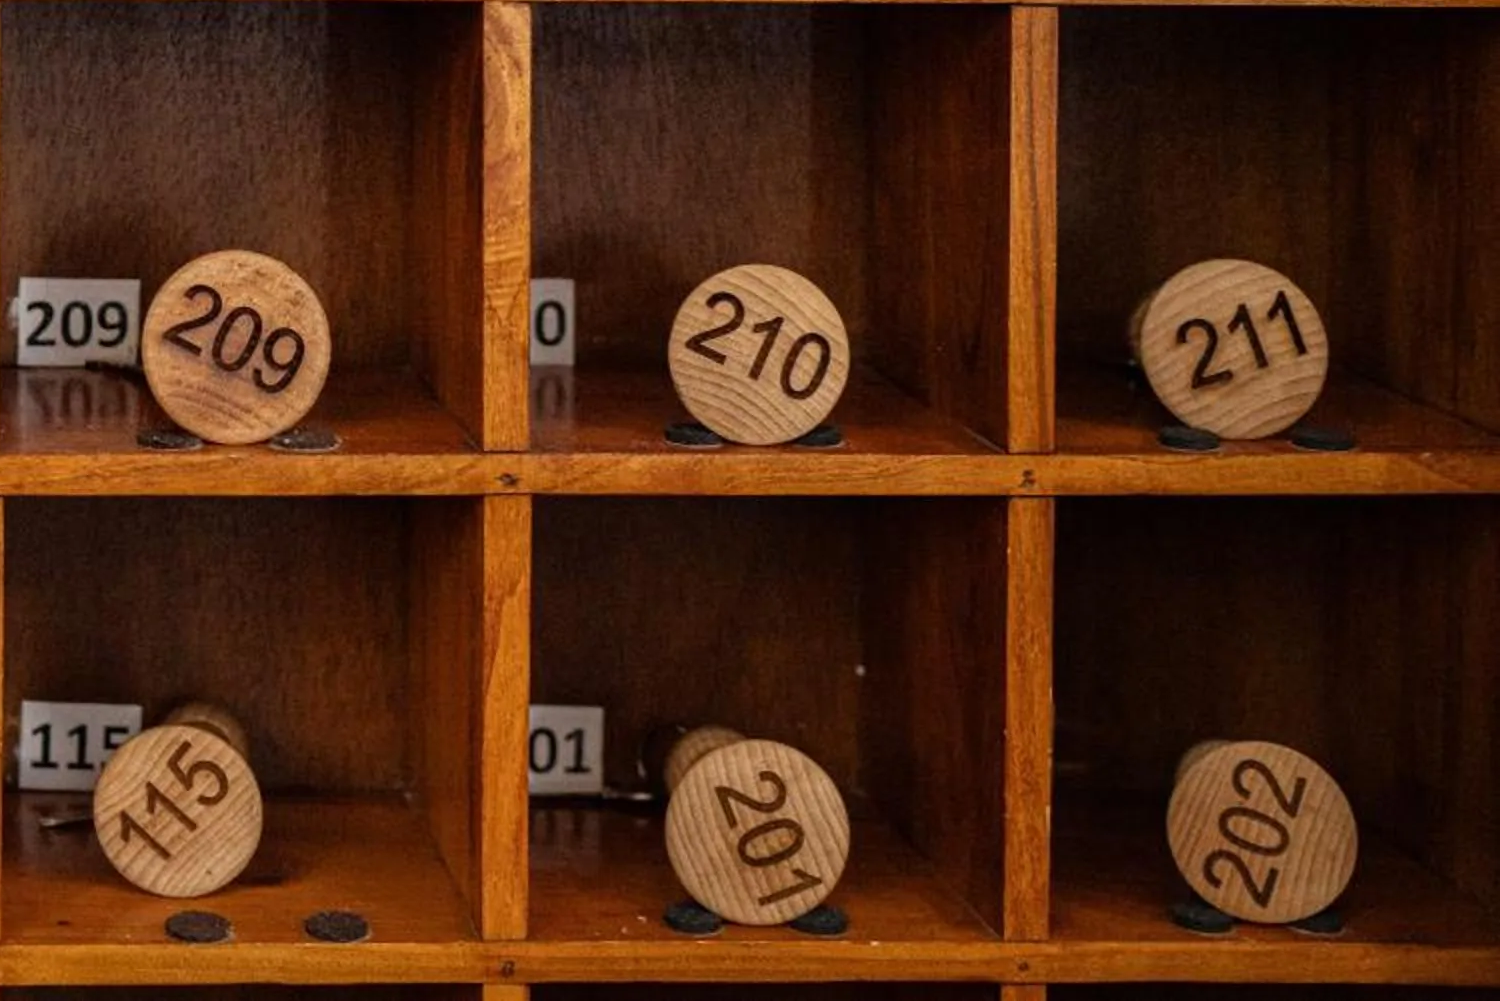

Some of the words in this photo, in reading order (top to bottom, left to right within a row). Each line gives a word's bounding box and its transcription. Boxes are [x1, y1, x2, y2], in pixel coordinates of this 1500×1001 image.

[25, 301, 128, 348] 209
[162, 284, 305, 393] 209
[685, 291, 831, 400] 210
[1175, 290, 1307, 390] 211
[119, 741, 229, 860] 115
[529, 728, 591, 774] 01
[715, 770, 822, 905] 201
[1203, 759, 1307, 908] 202
